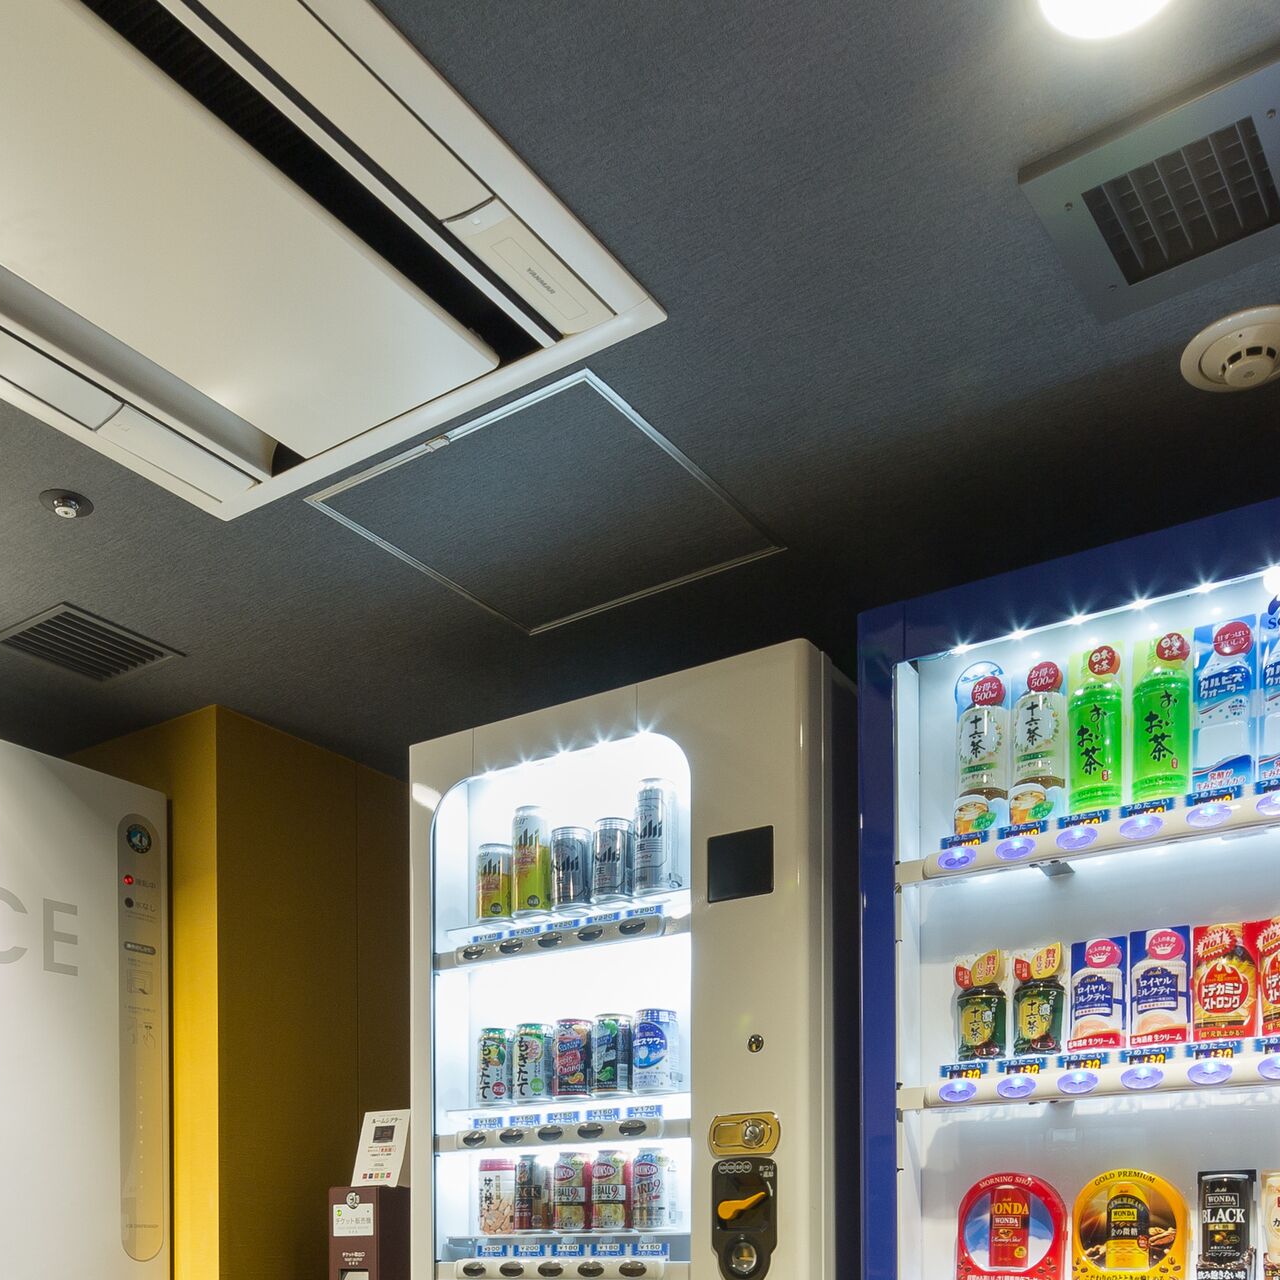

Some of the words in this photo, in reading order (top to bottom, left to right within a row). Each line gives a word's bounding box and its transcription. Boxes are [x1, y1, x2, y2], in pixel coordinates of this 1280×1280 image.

[1200, 673, 1243, 689] カルピス
[1025, 702, 1043, 746] 十六茶
[969, 714, 986, 759] 十六茶
[1140, 977, 1172, 986] ロイヤル
[1077, 984, 1107, 994] ロイヤル
[1202, 983, 1243, 998] ドデカミン
[1204, 997, 1240, 1010] ストロング
[969, 1007, 982, 1042] 十六茶
[1026, 1001, 1039, 1035] 十六茶
[980, 1176, 1013, 1189] MORNING
[1015, 1177, 1034, 1187] SHOT
[1095, 1174, 1115, 1186] GOLD
[1118, 1171, 1156, 1184] PREMIUM
[1208, 1196, 1235, 1205] WONDA
[991, 1203, 1029, 1215] ONDA
[1203, 1209, 1245, 1223] BLACK
